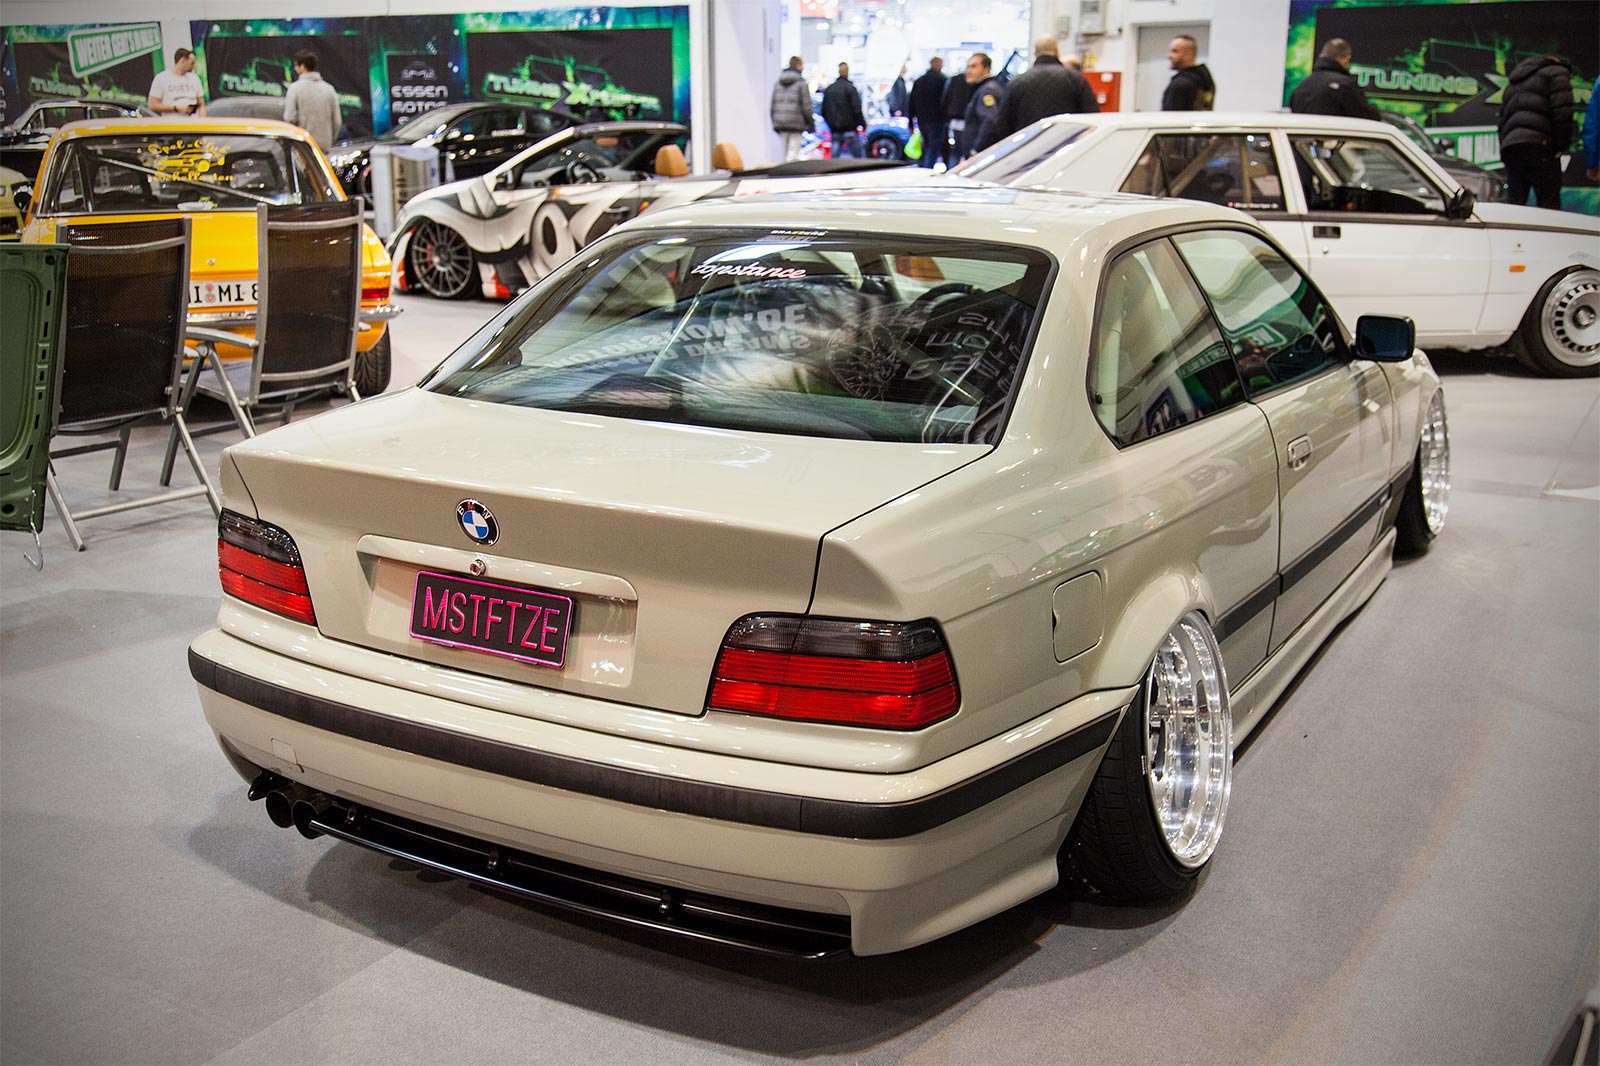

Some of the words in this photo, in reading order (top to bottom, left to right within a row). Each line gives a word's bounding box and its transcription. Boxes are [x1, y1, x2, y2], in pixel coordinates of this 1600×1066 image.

[75, 34, 113, 68] WEITER
[391, 85, 448, 98] ESSEN
[1349, 65, 1478, 96] TUNING
[691, 261, 807, 279] topstance
[422, 586, 560, 653] MSTFTZE
